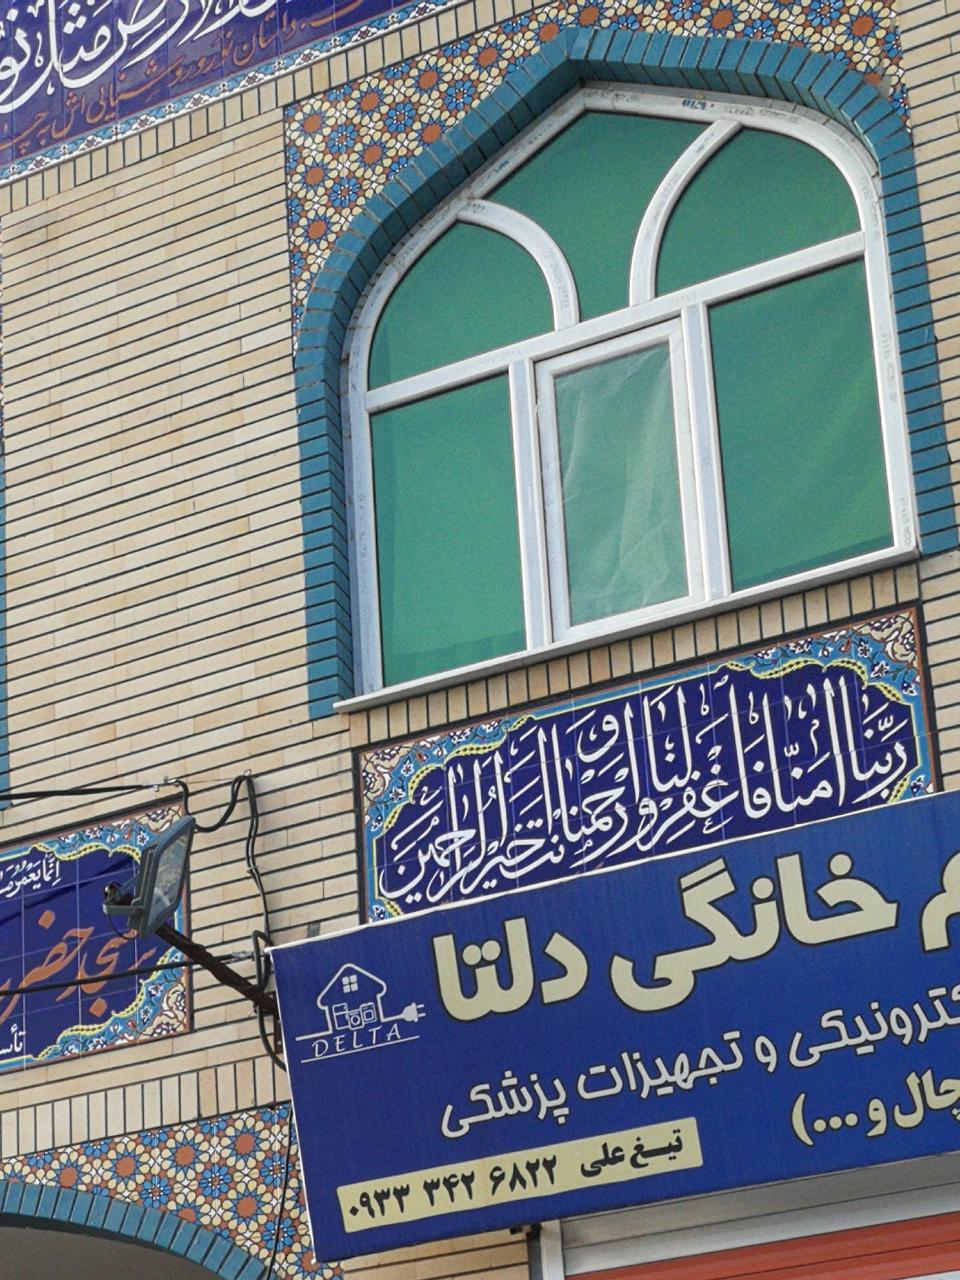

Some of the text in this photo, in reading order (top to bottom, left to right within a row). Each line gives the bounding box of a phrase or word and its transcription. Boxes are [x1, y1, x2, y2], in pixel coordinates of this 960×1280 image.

[610, 853, 899, 1012] خانگی
[432, 918, 589, 1021] دلتا
[311, 1023, 403, 1059] DELTA
[576, 1030, 744, 1100] تجهیزات
[754, 1035, 778, 1073] و
[440, 1069, 570, 1139] پزشکی
[348, 1129, 683, 1219] تیغ علی ۰۹۳۳ ۳۴۲ ۶۸۲۲
